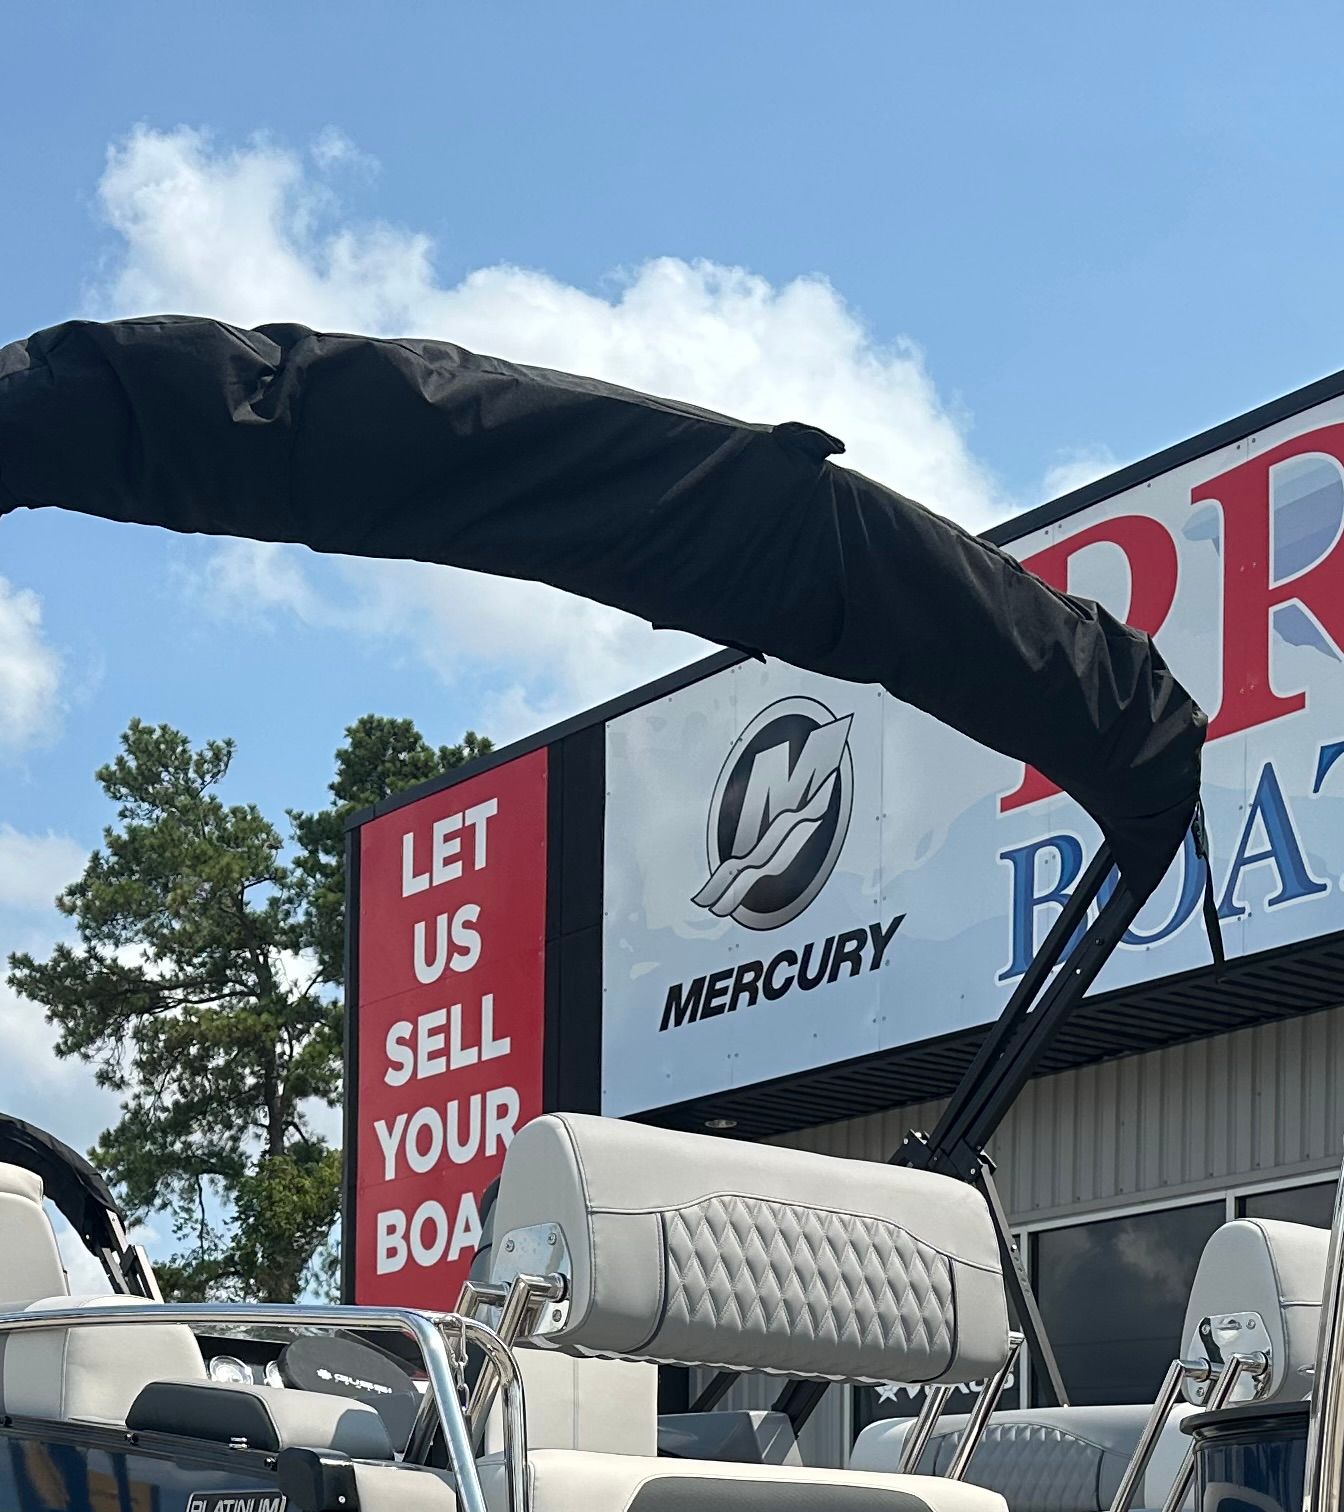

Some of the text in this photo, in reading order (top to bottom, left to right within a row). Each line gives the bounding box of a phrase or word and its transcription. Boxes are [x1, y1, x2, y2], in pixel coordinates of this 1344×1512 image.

[401, 798, 498, 897] LET
[412, 904, 481, 984] US
[659, 913, 907, 1032] MERCURY
[383, 993, 511, 1086] SELL
[373, 1086, 520, 1181] YOUR
[376, 1190, 485, 1275] BOA
